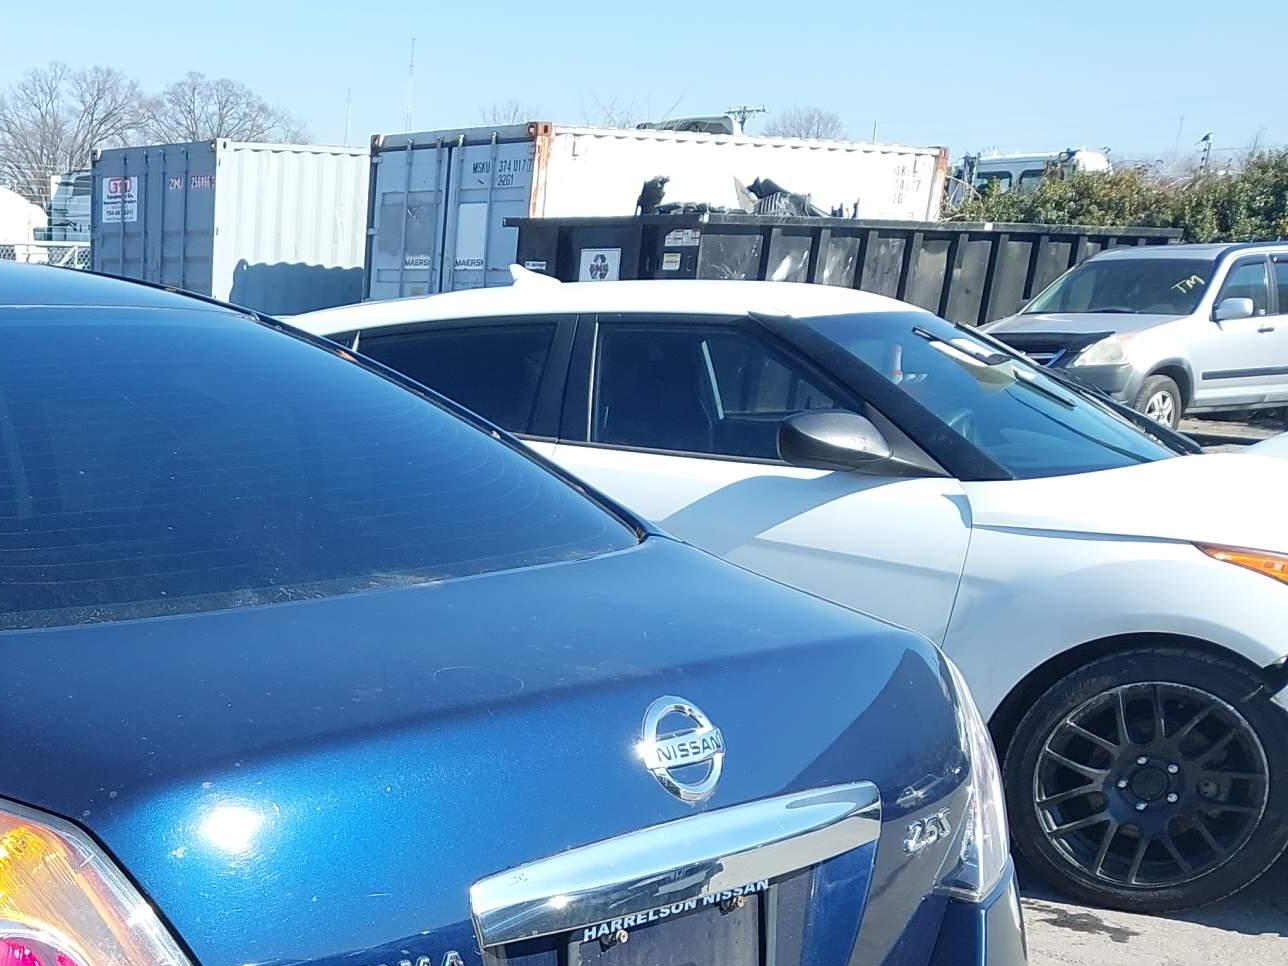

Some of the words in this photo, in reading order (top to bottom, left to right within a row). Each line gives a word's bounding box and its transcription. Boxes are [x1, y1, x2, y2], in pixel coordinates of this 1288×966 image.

[473, 162, 491, 174] MSKU
[1170, 275, 1206, 294] TM
[656, 732, 722, 762] NISSAN
[583, 900, 698, 942] HARRELSON
[702, 879, 769, 906] NISSAN
